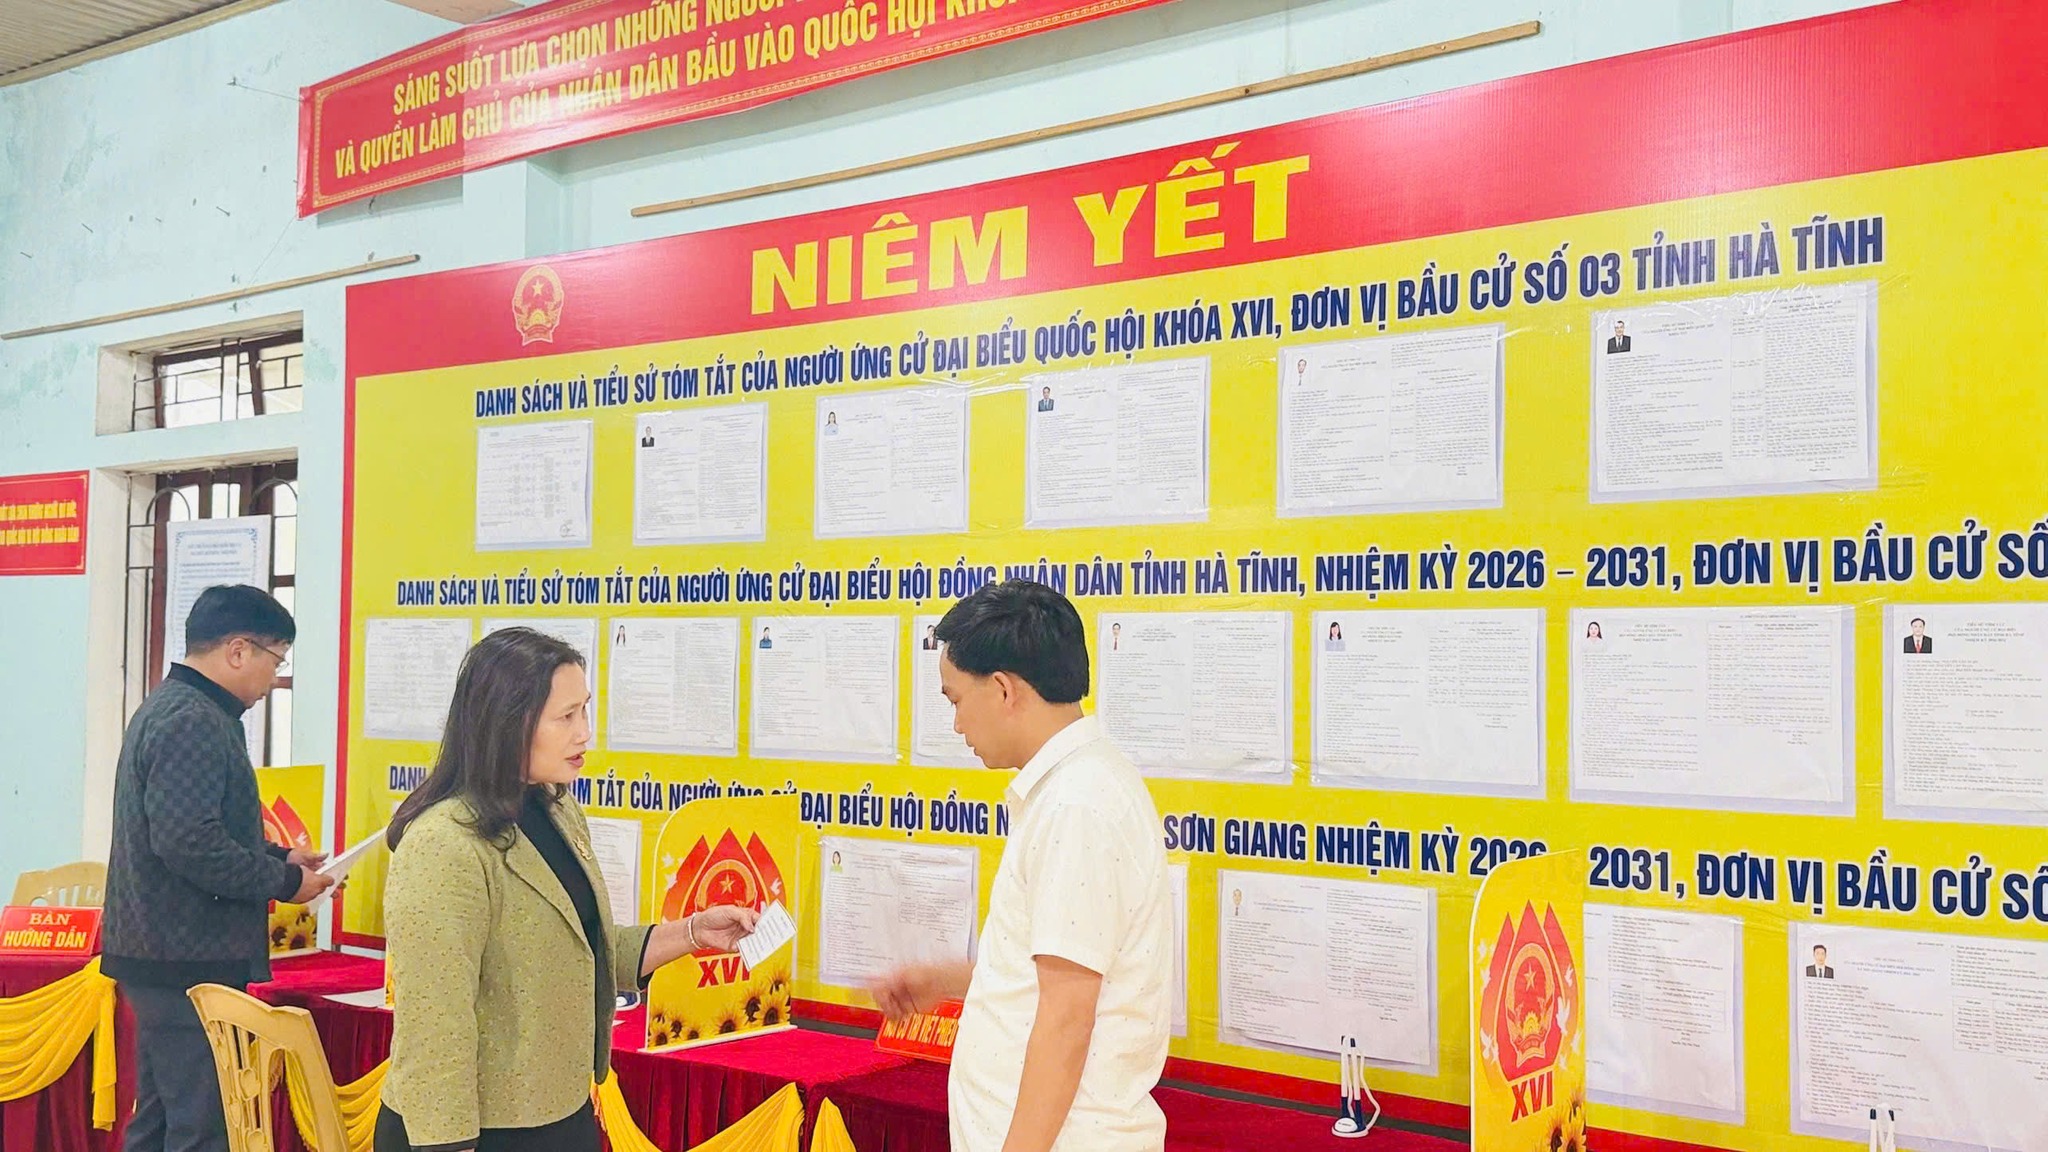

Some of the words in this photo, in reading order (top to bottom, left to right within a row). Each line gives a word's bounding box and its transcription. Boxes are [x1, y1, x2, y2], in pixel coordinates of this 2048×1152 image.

[335, 146, 356, 178] VÀ
[360, 122, 415, 173] QUYỀN
[419, 110, 457, 151] LÀM
[463, 94, 500, 142] CHỦ
[509, 87, 552, 134] CỦA
[559, 68, 622, 123] NHÂN
[629, 52, 679, 100] DÂN
[686, 30, 736, 86] BẦU
[743, 22, 796, 71] VÀO
[394, 72, 440, 115] SÁNG
[445, 46, 494, 94] SUỐT
[500, 39, 539, 87] LỰA
[547, 25, 607, 75] CHỌN
[614, 0, 697, 52] NHỮNG
[752, 206, 1028, 314] NIÊM
[1073, 142, 1310, 267] YẾT
[477, 388, 516, 417] DANH
[522, 383, 562, 413] SÁCH
[569, 374, 587, 408] VÀ
[594, 364, 628, 406] TIỂU
[635, 363, 658, 402] SỬ
[662, 364, 698, 400] TÓM
[705, 354, 735, 395] TẮT
[742, 351, 777, 392] CỦA
[785, 345, 843, 387] NGƯỜI
[851, 343, 891, 380] ỨNG
[900, 338, 928, 375] CỬ
[934, 341, 967, 377] ĐẠI
[979, 318, 1025, 366] BIỂU
[1035, 310, 1095, 364] QUỐC
[1106, 309, 1144, 358] HỘI
[1154, 300, 1221, 347] KHÓA
[1231, 298, 1281, 338] XVI,
[1291, 287, 1349, 331] ĐƠN
[1360, 283, 1386, 330] VỊ
[1398, 263, 1458, 319] BẦU
[1471, 253, 1516, 310] CỬ
[1524, 243, 1568, 303] SỐ
[1580, 253, 1620, 297] 03
[1633, 231, 1714, 290] TỈNH
[1730, 222, 1779, 278] HÀ
[1793, 215, 1882, 270] TĨNH
[398, 581, 434, 605] DANH
[440, 574, 476, 605] SÁCH
[482, 574, 499, 604] VÀ
[505, 567, 535, 604] TIỂU
[542, 569, 563, 604] SỬ
[567, 572, 599, 604] TÓM
[605, 567, 633, 603] TẮT
[639, 567, 671, 603] CỦA
[678, 568, 729, 602] NGƯỜI
[736, 568, 772, 602] ỨNG
[779, 562, 805, 601] CỬ
[809, 572, 840, 607] ĐẠI
[848, 558, 891, 600] BIỂU
[899, 562, 931, 605] HỘI
[938, 557, 997, 599] ĐỒNG
[1075, 556, 1122, 595] DÂN
[1131, 550, 1185, 594] TỈNH
[1196, 552, 1228, 593] HÀ
[1238, 552, 1305, 596] TĨNH,
[1316, 547, 1408, 599] NHIỆM
[1420, 544, 1457, 589] KỲ
[1468, 550, 1544, 588] 2026
[1587, 547, 1680, 590] 2031,
[1694, 539, 1770, 584] ĐƠN
[1784, 541, 1818, 592] VỊ
[1834, 523, 1912, 582] BẦU
[1929, 520, 1987, 580] CỬ
[597, 769, 624, 807] TẮT
[631, 773, 662, 810] CỦA
[801, 792, 832, 829] ĐẠI
[840, 783, 883, 827] BIỂU
[891, 792, 923, 836] HỘI
[930, 791, 988, 834] ĐỒNG
[1164, 814, 1214, 852] SƠN
[1225, 819, 1305, 860] GIANG
[1317, 821, 1409, 875] NHIỆM
[1422, 827, 1459, 873] KỲ
[1590, 847, 1684, 898] 2031,
[1697, 852, 1774, 900] ĐƠN
[1788, 860, 1822, 914] VỊ
[1838, 850, 1916, 911] BẦU
[1933, 856, 1991, 916] CỬ
[2, 927, 53, 948] HƯỚNG
[54, 925, 87, 948] DẪN
[28, 910, 72, 925] BÀN
[1511, 1071, 1554, 1122] XVI
